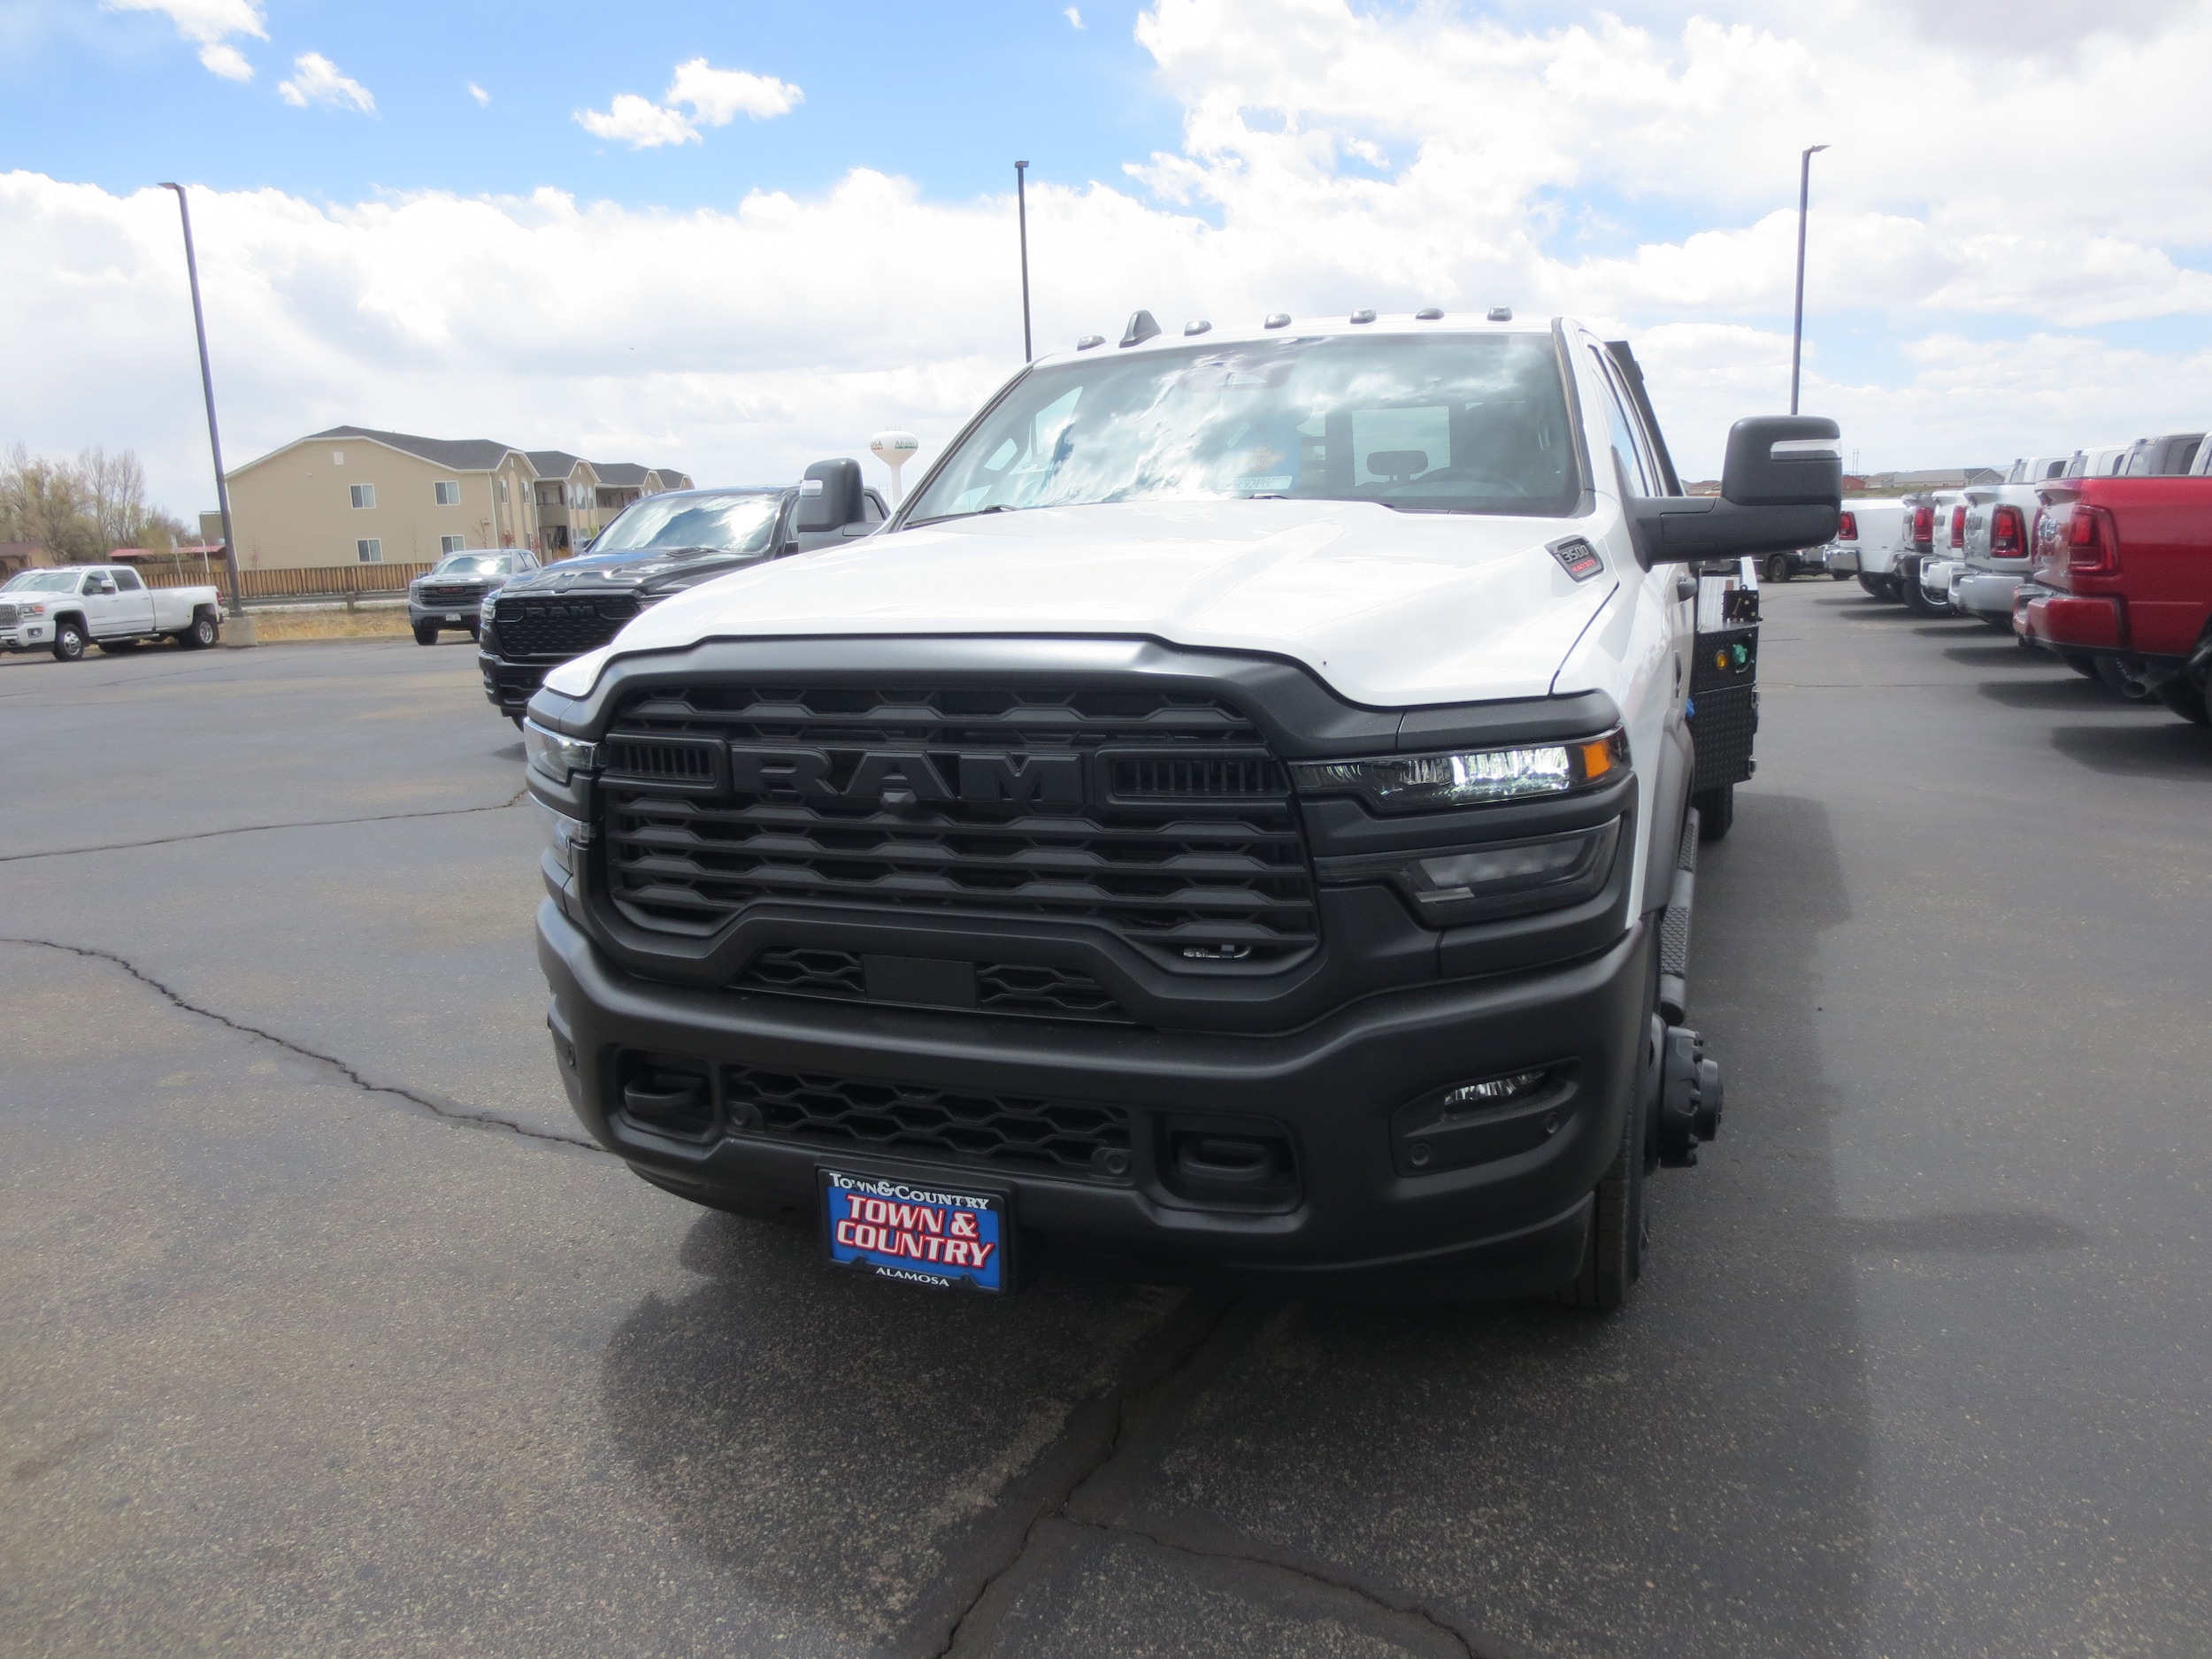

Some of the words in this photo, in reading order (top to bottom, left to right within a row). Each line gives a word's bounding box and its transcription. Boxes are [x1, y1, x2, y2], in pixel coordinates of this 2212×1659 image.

[1562, 545, 1589, 564] 3500
[526, 605, 595, 618] RAM
[732, 745, 1081, 803] RAM
[846, 1194, 945, 1235] TOWN
[950, 1210, 979, 1239] &
[836, 1219, 995, 1268] COUNTRY
[876, 1266, 949, 1286] ALAMOSA
